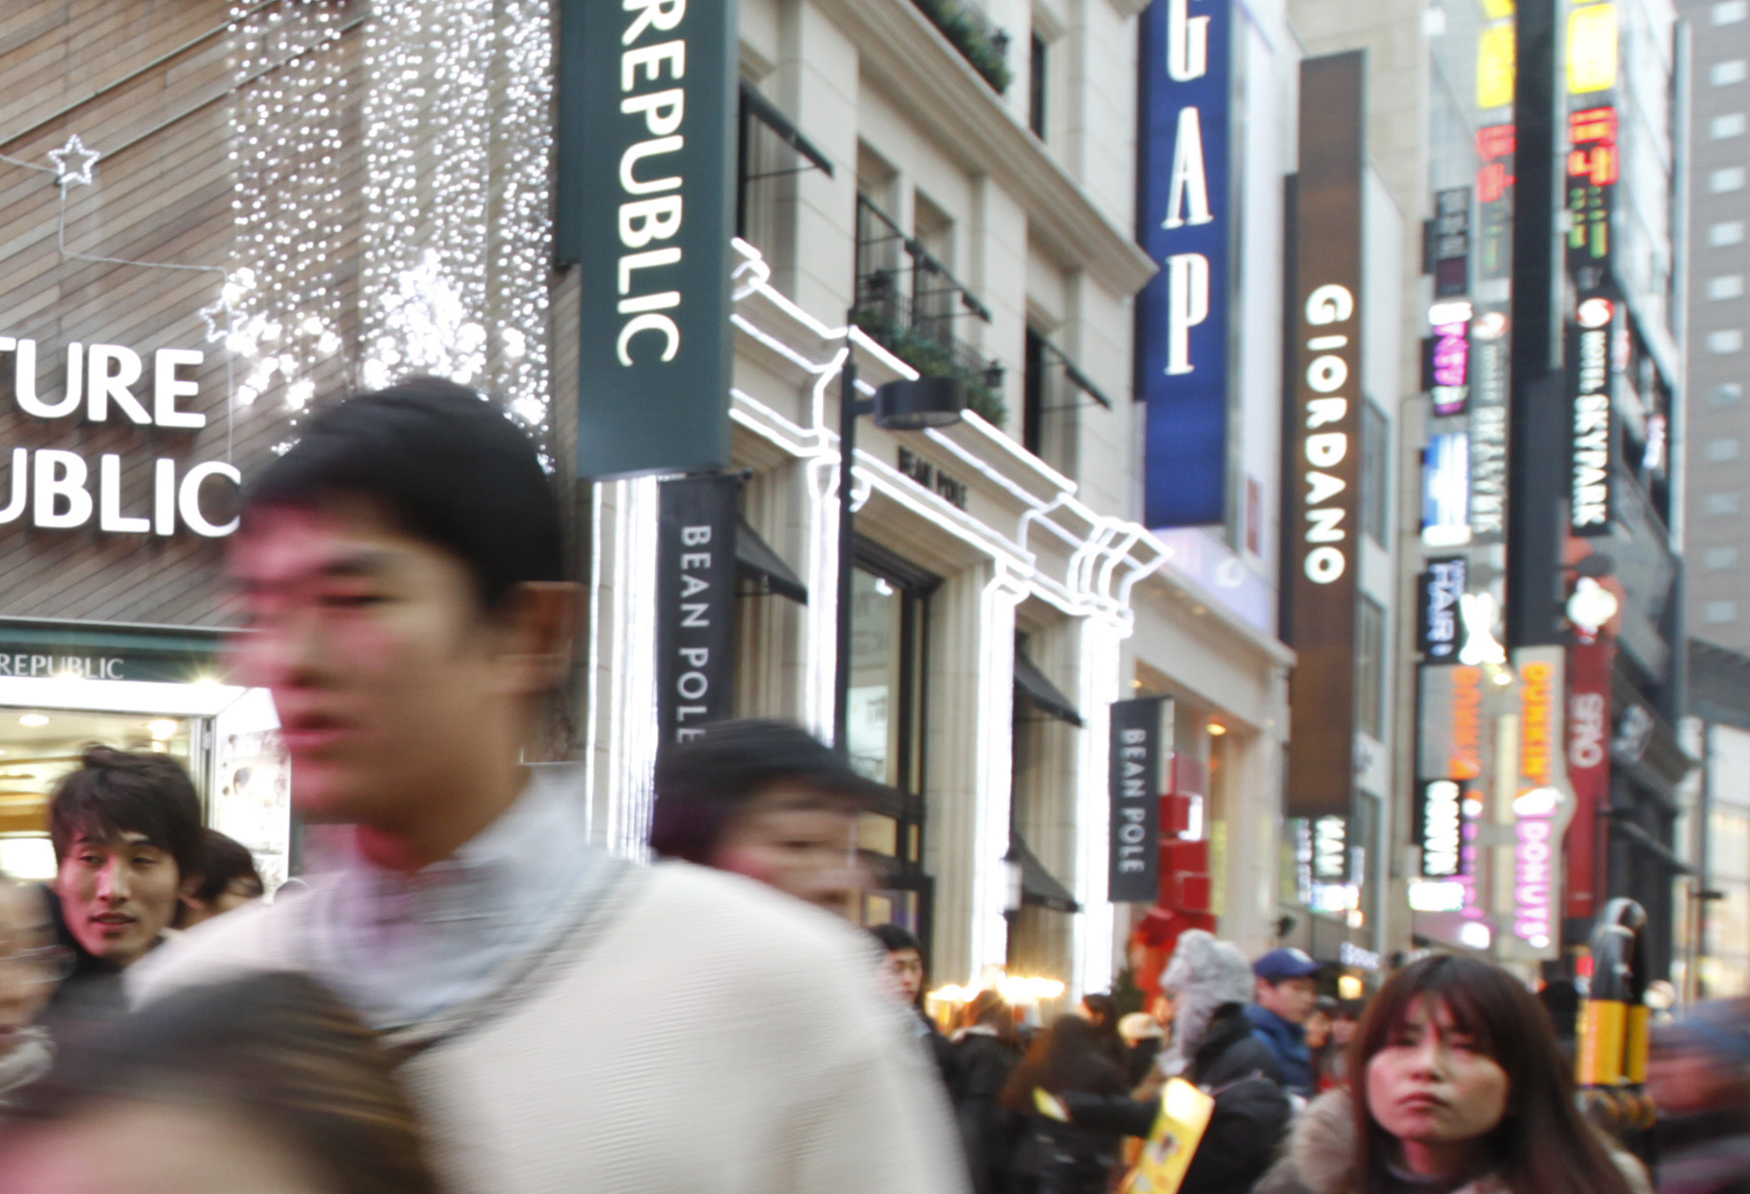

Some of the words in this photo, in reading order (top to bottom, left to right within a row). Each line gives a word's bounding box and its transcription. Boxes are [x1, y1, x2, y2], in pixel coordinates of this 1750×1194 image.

[616, 0, 686, 367] REPUBLIC
[1161, 0, 1213, 376] GAP
[1305, 284, 1354, 584] GIORDANO
[1572, 394, 1609, 527] SKYPARK
[680, 525, 712, 628] BEAN
[676, 647, 709, 744] POLE
[1119, 728, 1146, 798] BEAN
[1118, 807, 1146, 874] POLE
[1514, 818, 1552, 938] DONUTS
